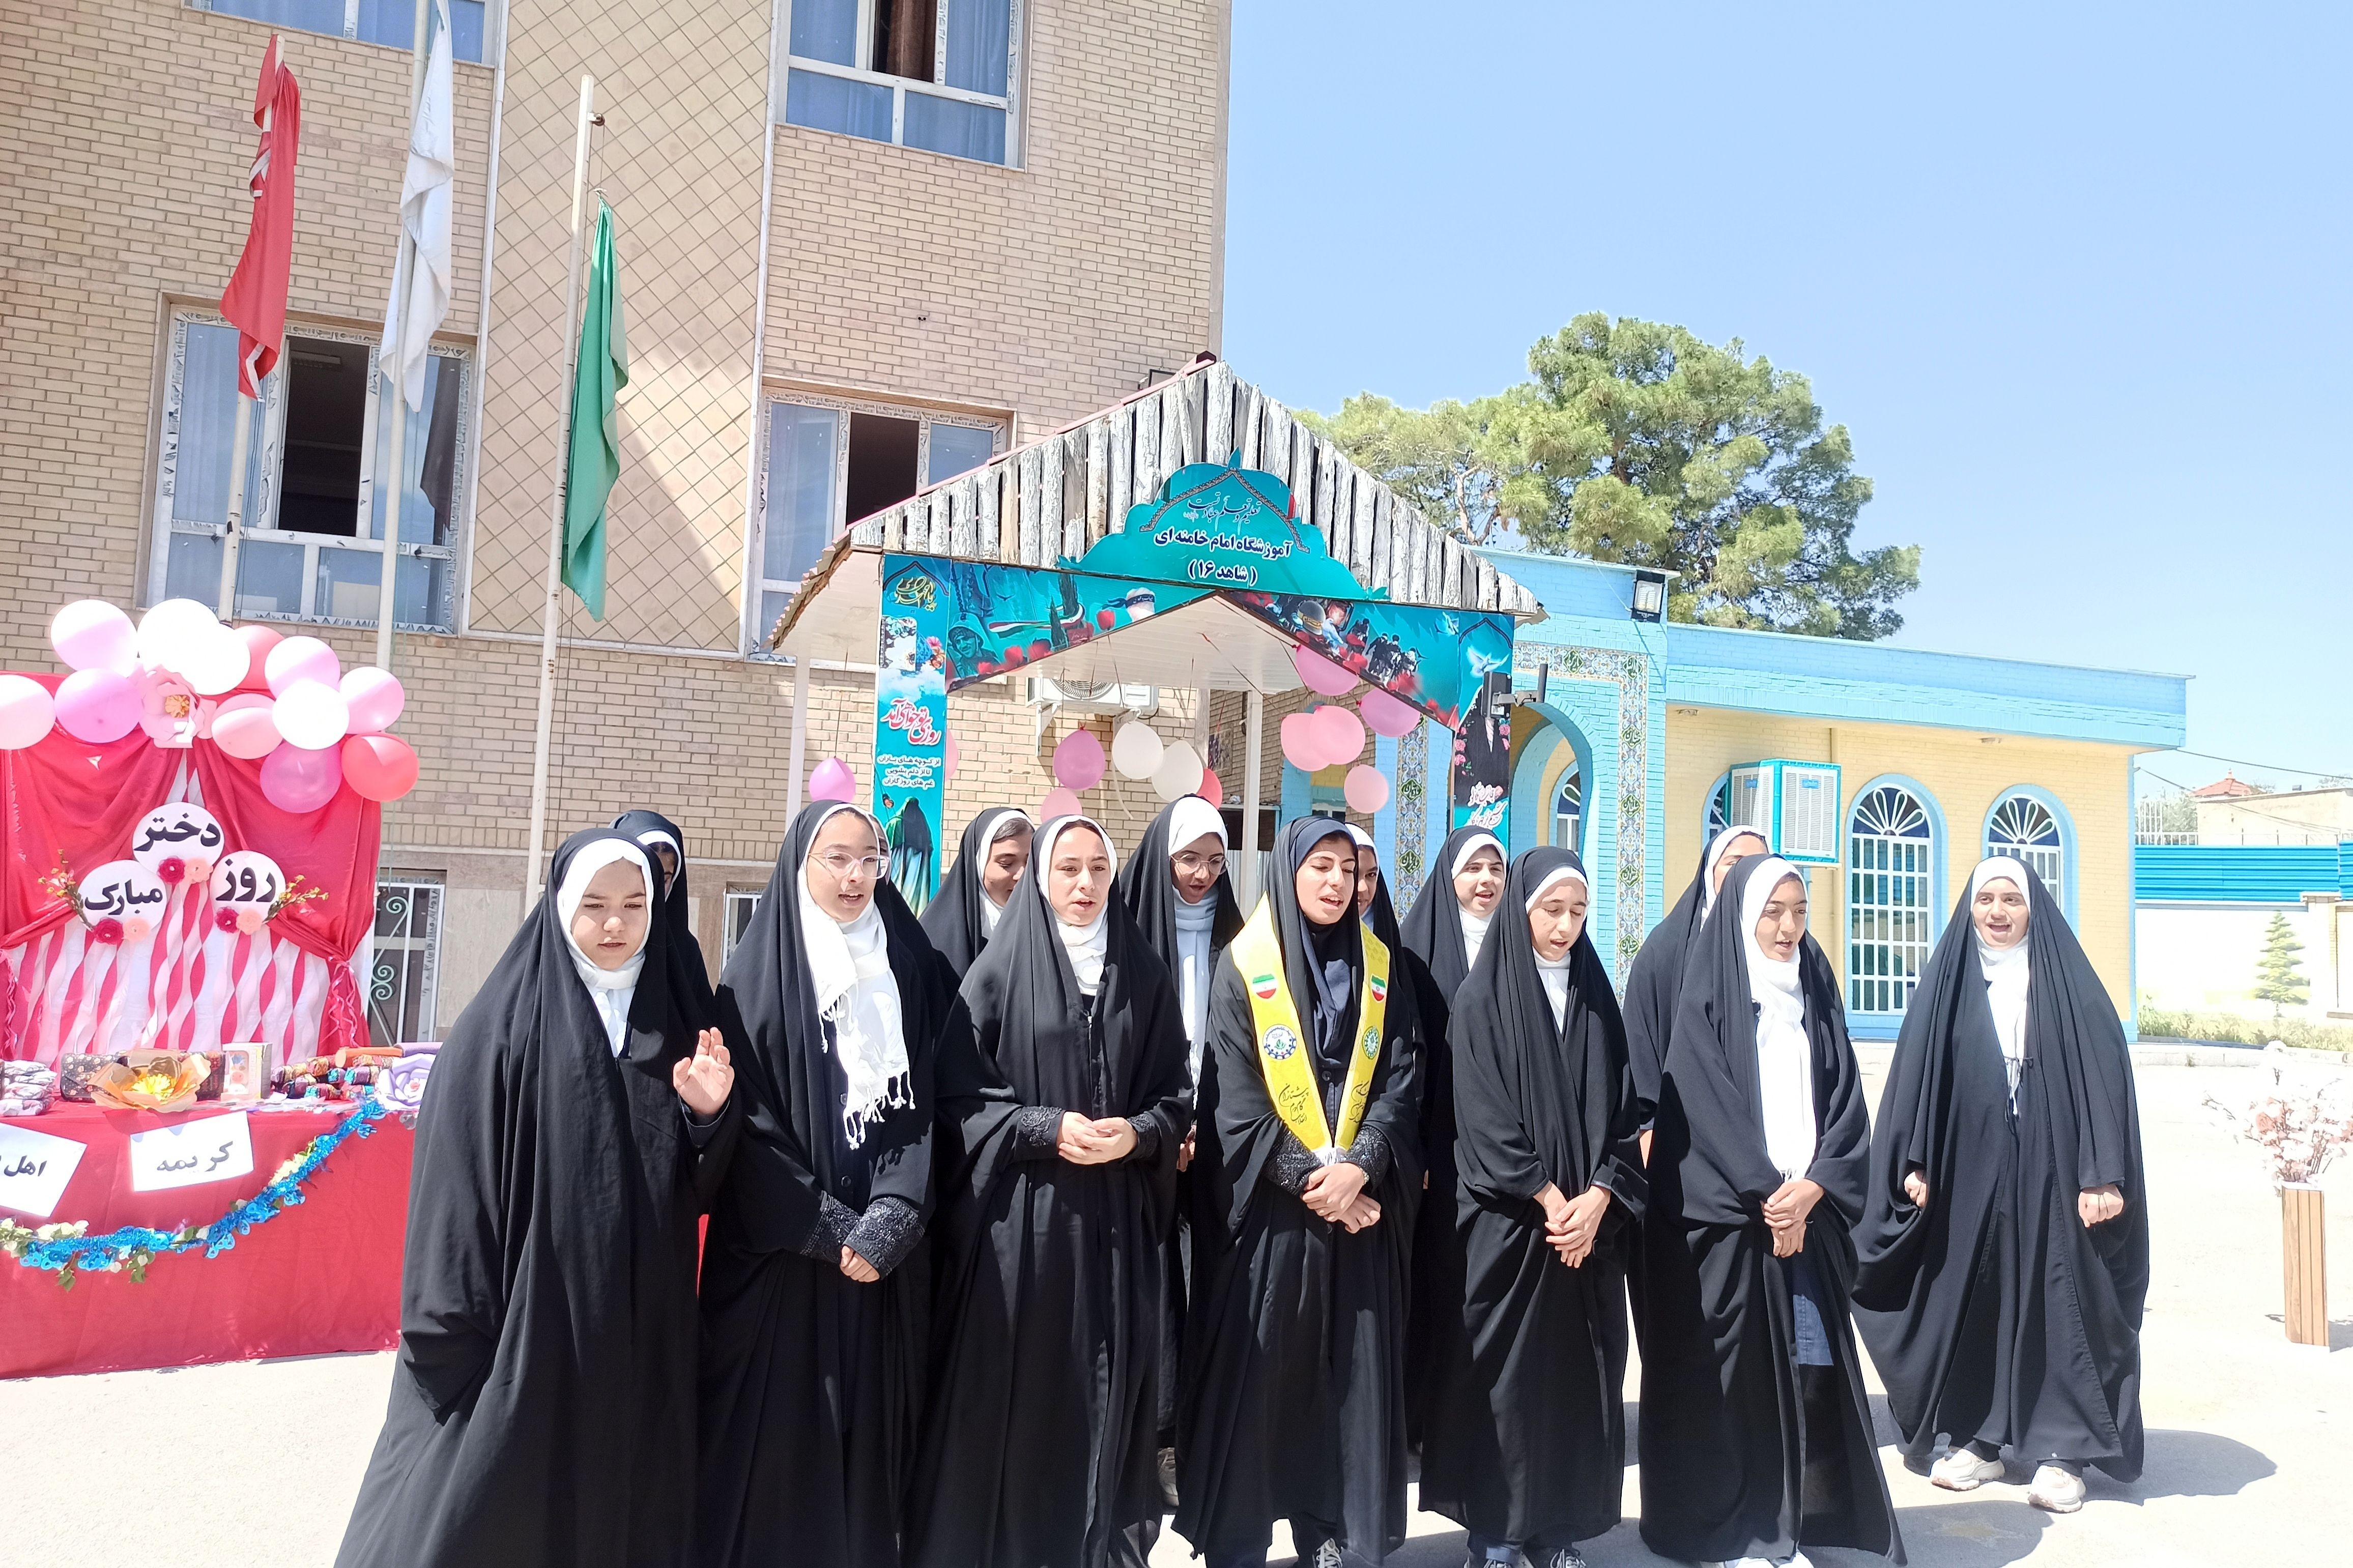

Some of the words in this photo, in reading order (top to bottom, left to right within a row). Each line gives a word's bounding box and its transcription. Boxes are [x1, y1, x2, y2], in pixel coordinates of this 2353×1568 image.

[1232, 513, 1240, 523] و
[1237, 501, 1262, 536] تعلیم
[1153, 526, 1174, 546] ای
[1174, 528, 1210, 546] خامنه
[1209, 532, 1236, 553] امام
[1236, 536, 1294, 560] آموزشگاه
[880, 697, 908, 721] آمد
[907, 717, 942, 745] روزی
[884, 777, 910, 786] روزگاران
[907, 768, 920, 776] دلم
[924, 779, 934, 788] غم
[132, 812, 221, 852] دختر
[215, 858, 276, 903] روز
[83, 878, 163, 915] مبارک
[1278, 1082, 1309, 1108] پیشتازان
[4, 1154, 47, 1177] اهل
[156, 1140, 234, 1173] کریمه
